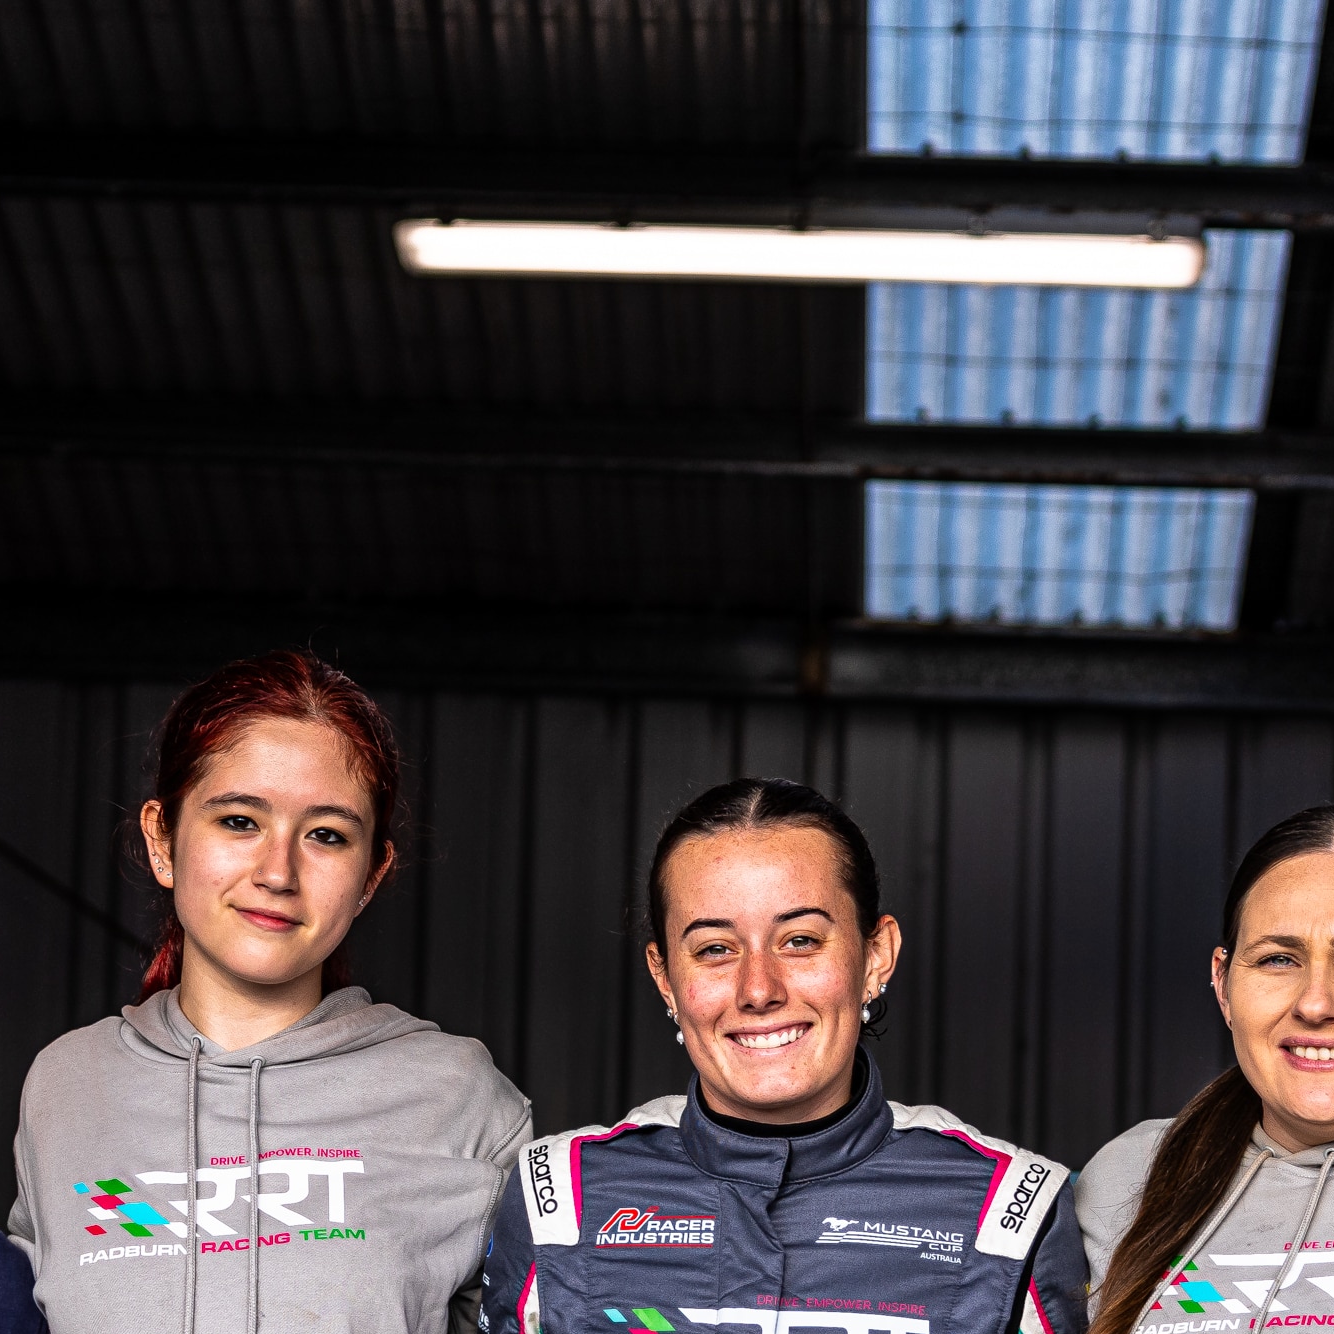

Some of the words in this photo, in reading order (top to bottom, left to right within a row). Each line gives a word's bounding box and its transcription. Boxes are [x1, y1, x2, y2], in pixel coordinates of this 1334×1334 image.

[210, 1155, 249, 1166] DRIVE.
[257, 1147, 315, 1160] MPOWER.
[317, 1148, 364, 1158] INSPIRE.
[529, 1144, 559, 1215] sparco
[135, 1160, 365, 1238] RRT
[1000, 1162, 1049, 1232] sparco
[646, 1219, 715, 1231] RACER
[863, 1220, 965, 1244] MUSTANG
[79, 1243, 188, 1266] RADBURN
[201, 1232, 291, 1254] RACNG
[299, 1227, 366, 1241] TEAM
[596, 1231, 715, 1245] INDUSTRIES
[928, 1242, 964, 1252] CUP
[1283, 1241, 1321, 1250] DIVE.
[920, 1251, 962, 1264] AUSTRALIA
[806, 1298, 874, 1311] EMPOWER.
[878, 1302, 929, 1317] INSPIRE.
